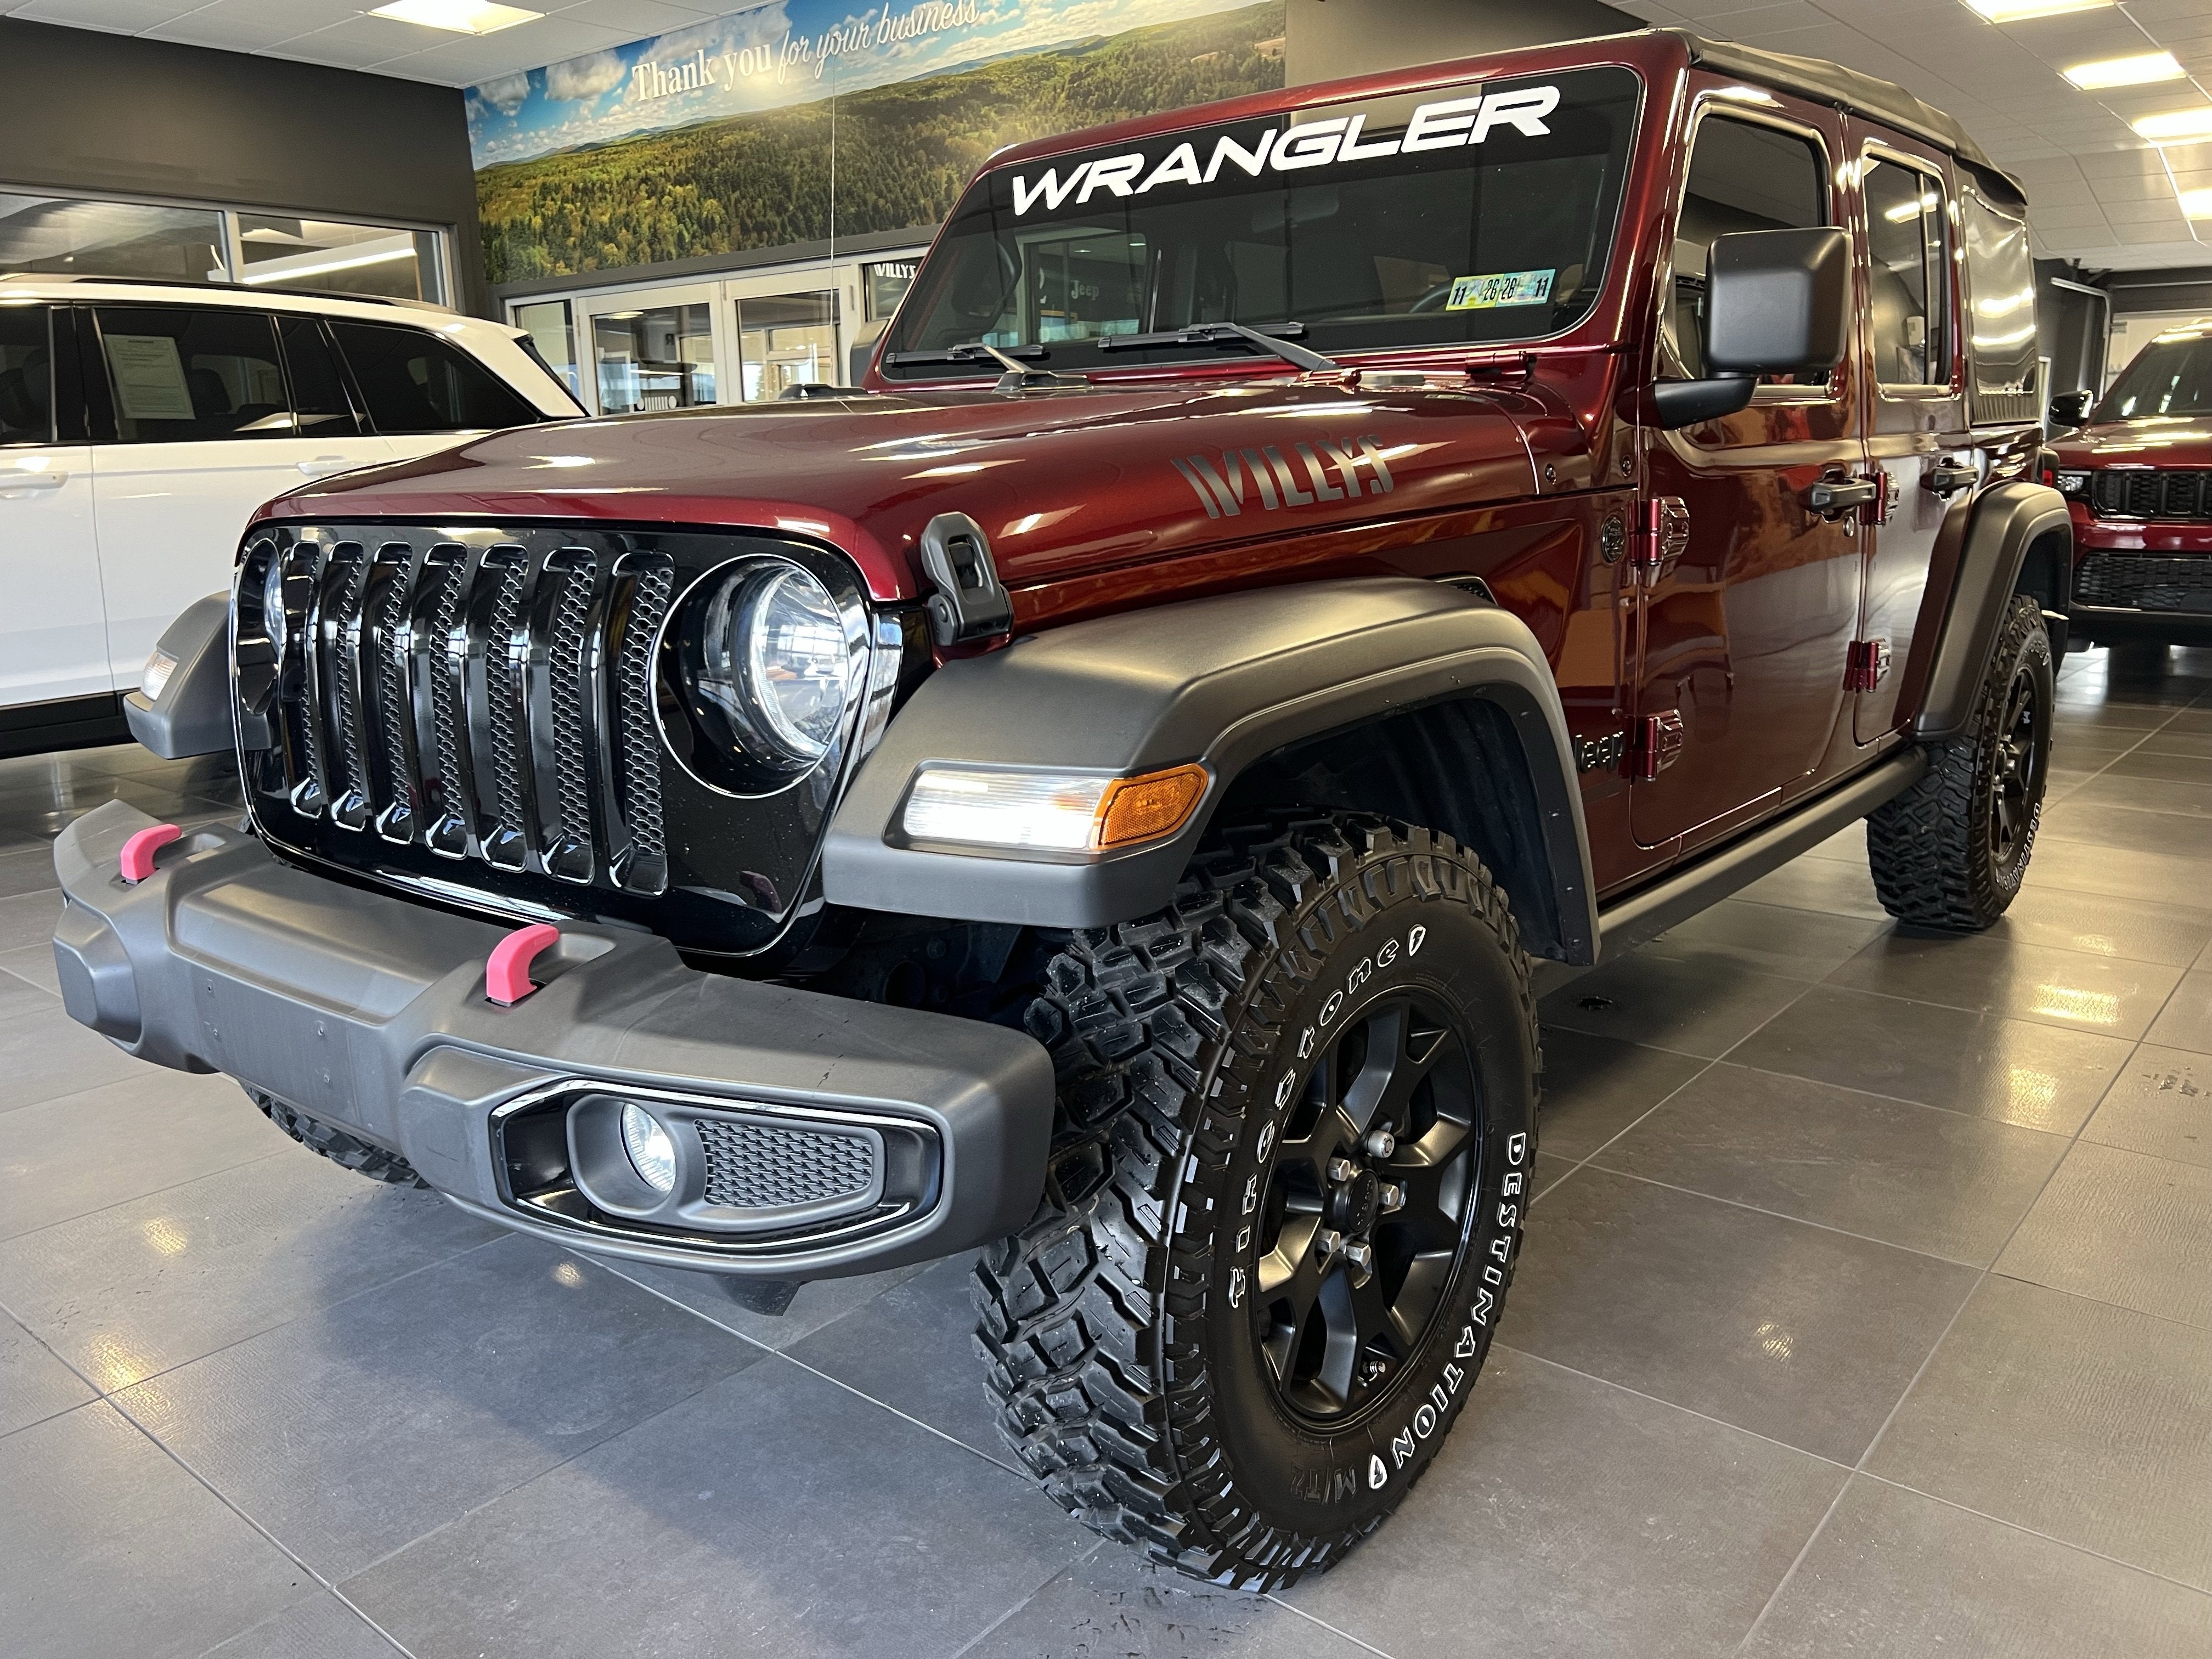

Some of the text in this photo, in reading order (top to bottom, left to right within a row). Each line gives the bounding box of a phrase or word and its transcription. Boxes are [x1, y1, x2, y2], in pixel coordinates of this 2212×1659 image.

[631, 0, 980, 103] Thank you for your business
[1012, 85, 1561, 216] WRANGLER
[873, 263, 916, 279] WILLYS
[1070, 279, 1099, 301] Jeep
[1452, 279, 1500, 305] 11 26
[1536, 277, 1549, 297] 11
[1170, 434, 1394, 519] WILLYS
[1228, 938, 1400, 1309] Firestone
[1391, 1132, 1527, 1470] DESTINATION
